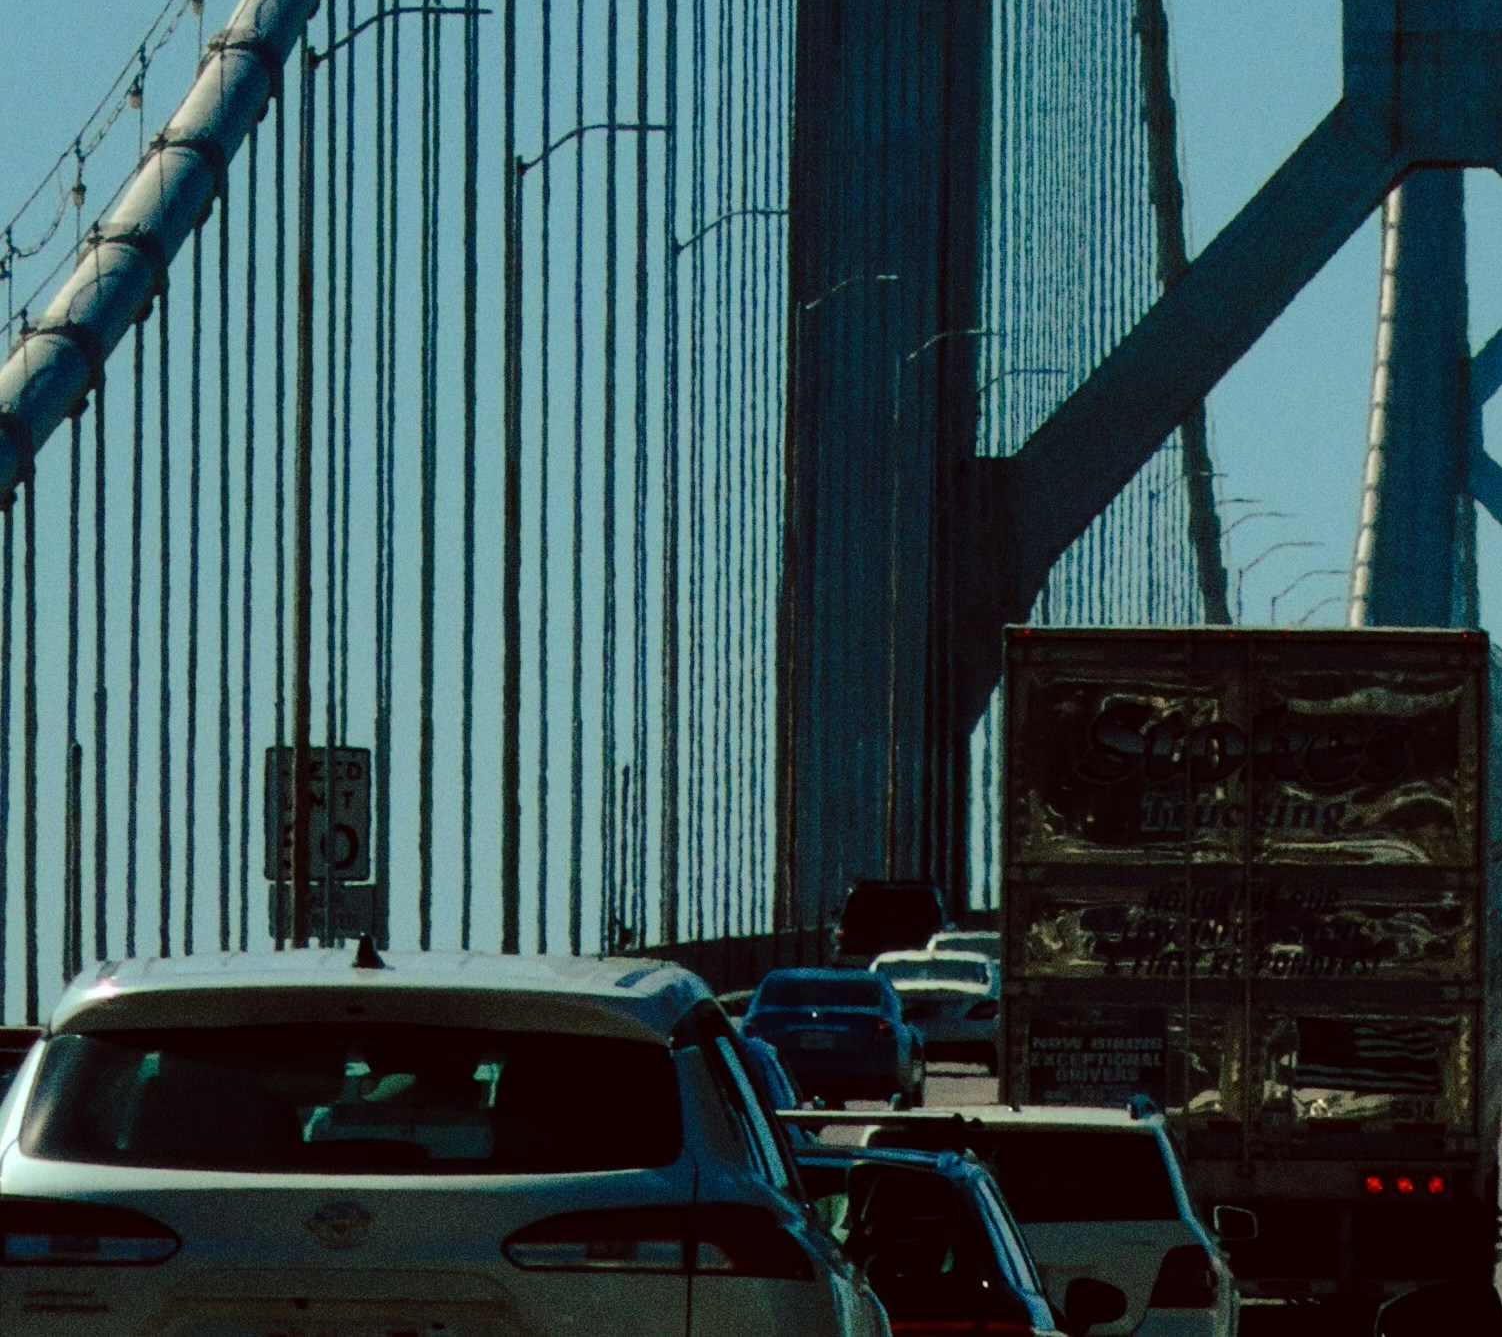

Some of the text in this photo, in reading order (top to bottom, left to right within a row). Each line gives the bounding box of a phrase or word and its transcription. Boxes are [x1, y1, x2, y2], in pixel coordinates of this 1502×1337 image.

[281, 760, 362, 780] EED
[282, 791, 356, 809] LMT
[282, 823, 359, 870] 0
[1210, 951, 1380, 977] REPONDERS!
[1031, 1035, 1085, 1050] NOW
